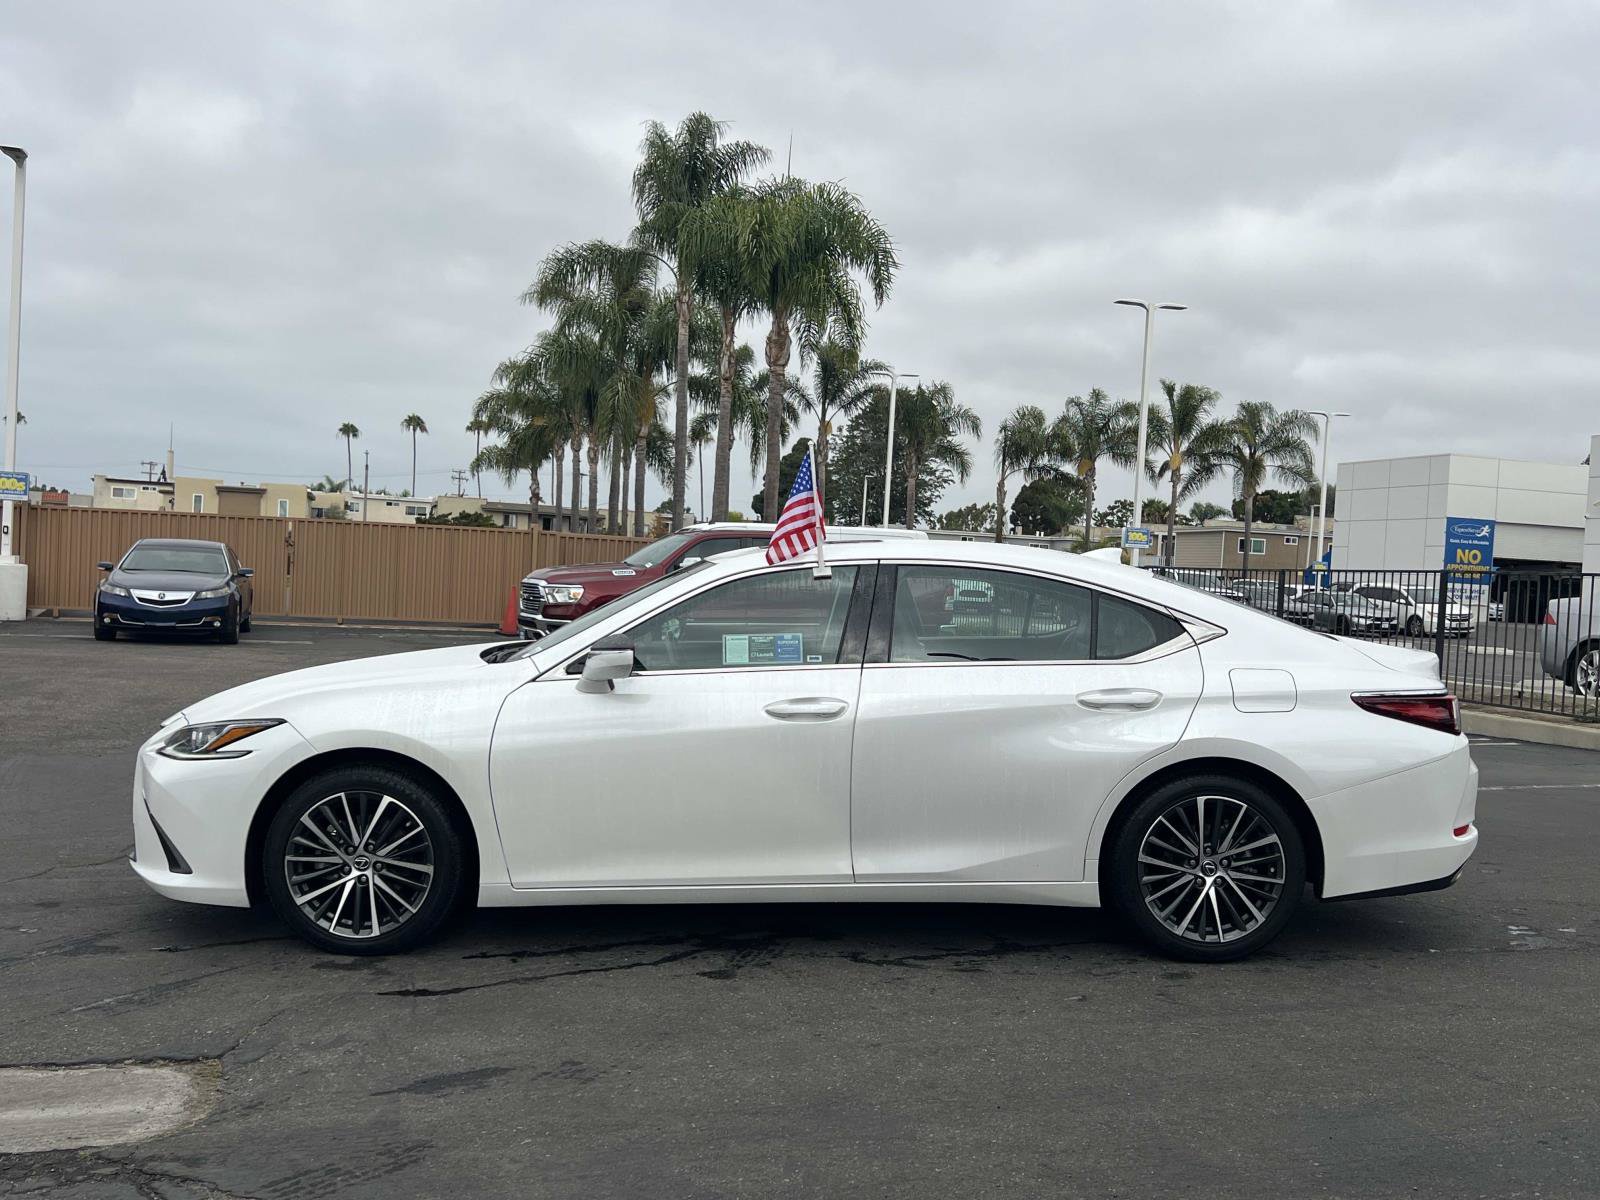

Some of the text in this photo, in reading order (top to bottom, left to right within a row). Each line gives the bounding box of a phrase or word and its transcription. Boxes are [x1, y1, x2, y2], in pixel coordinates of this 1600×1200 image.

[0, 477, 26, 490] 00s
[1456, 549, 1481, 564] NO
[1446, 563, 1490, 572] APPOINTMENT
